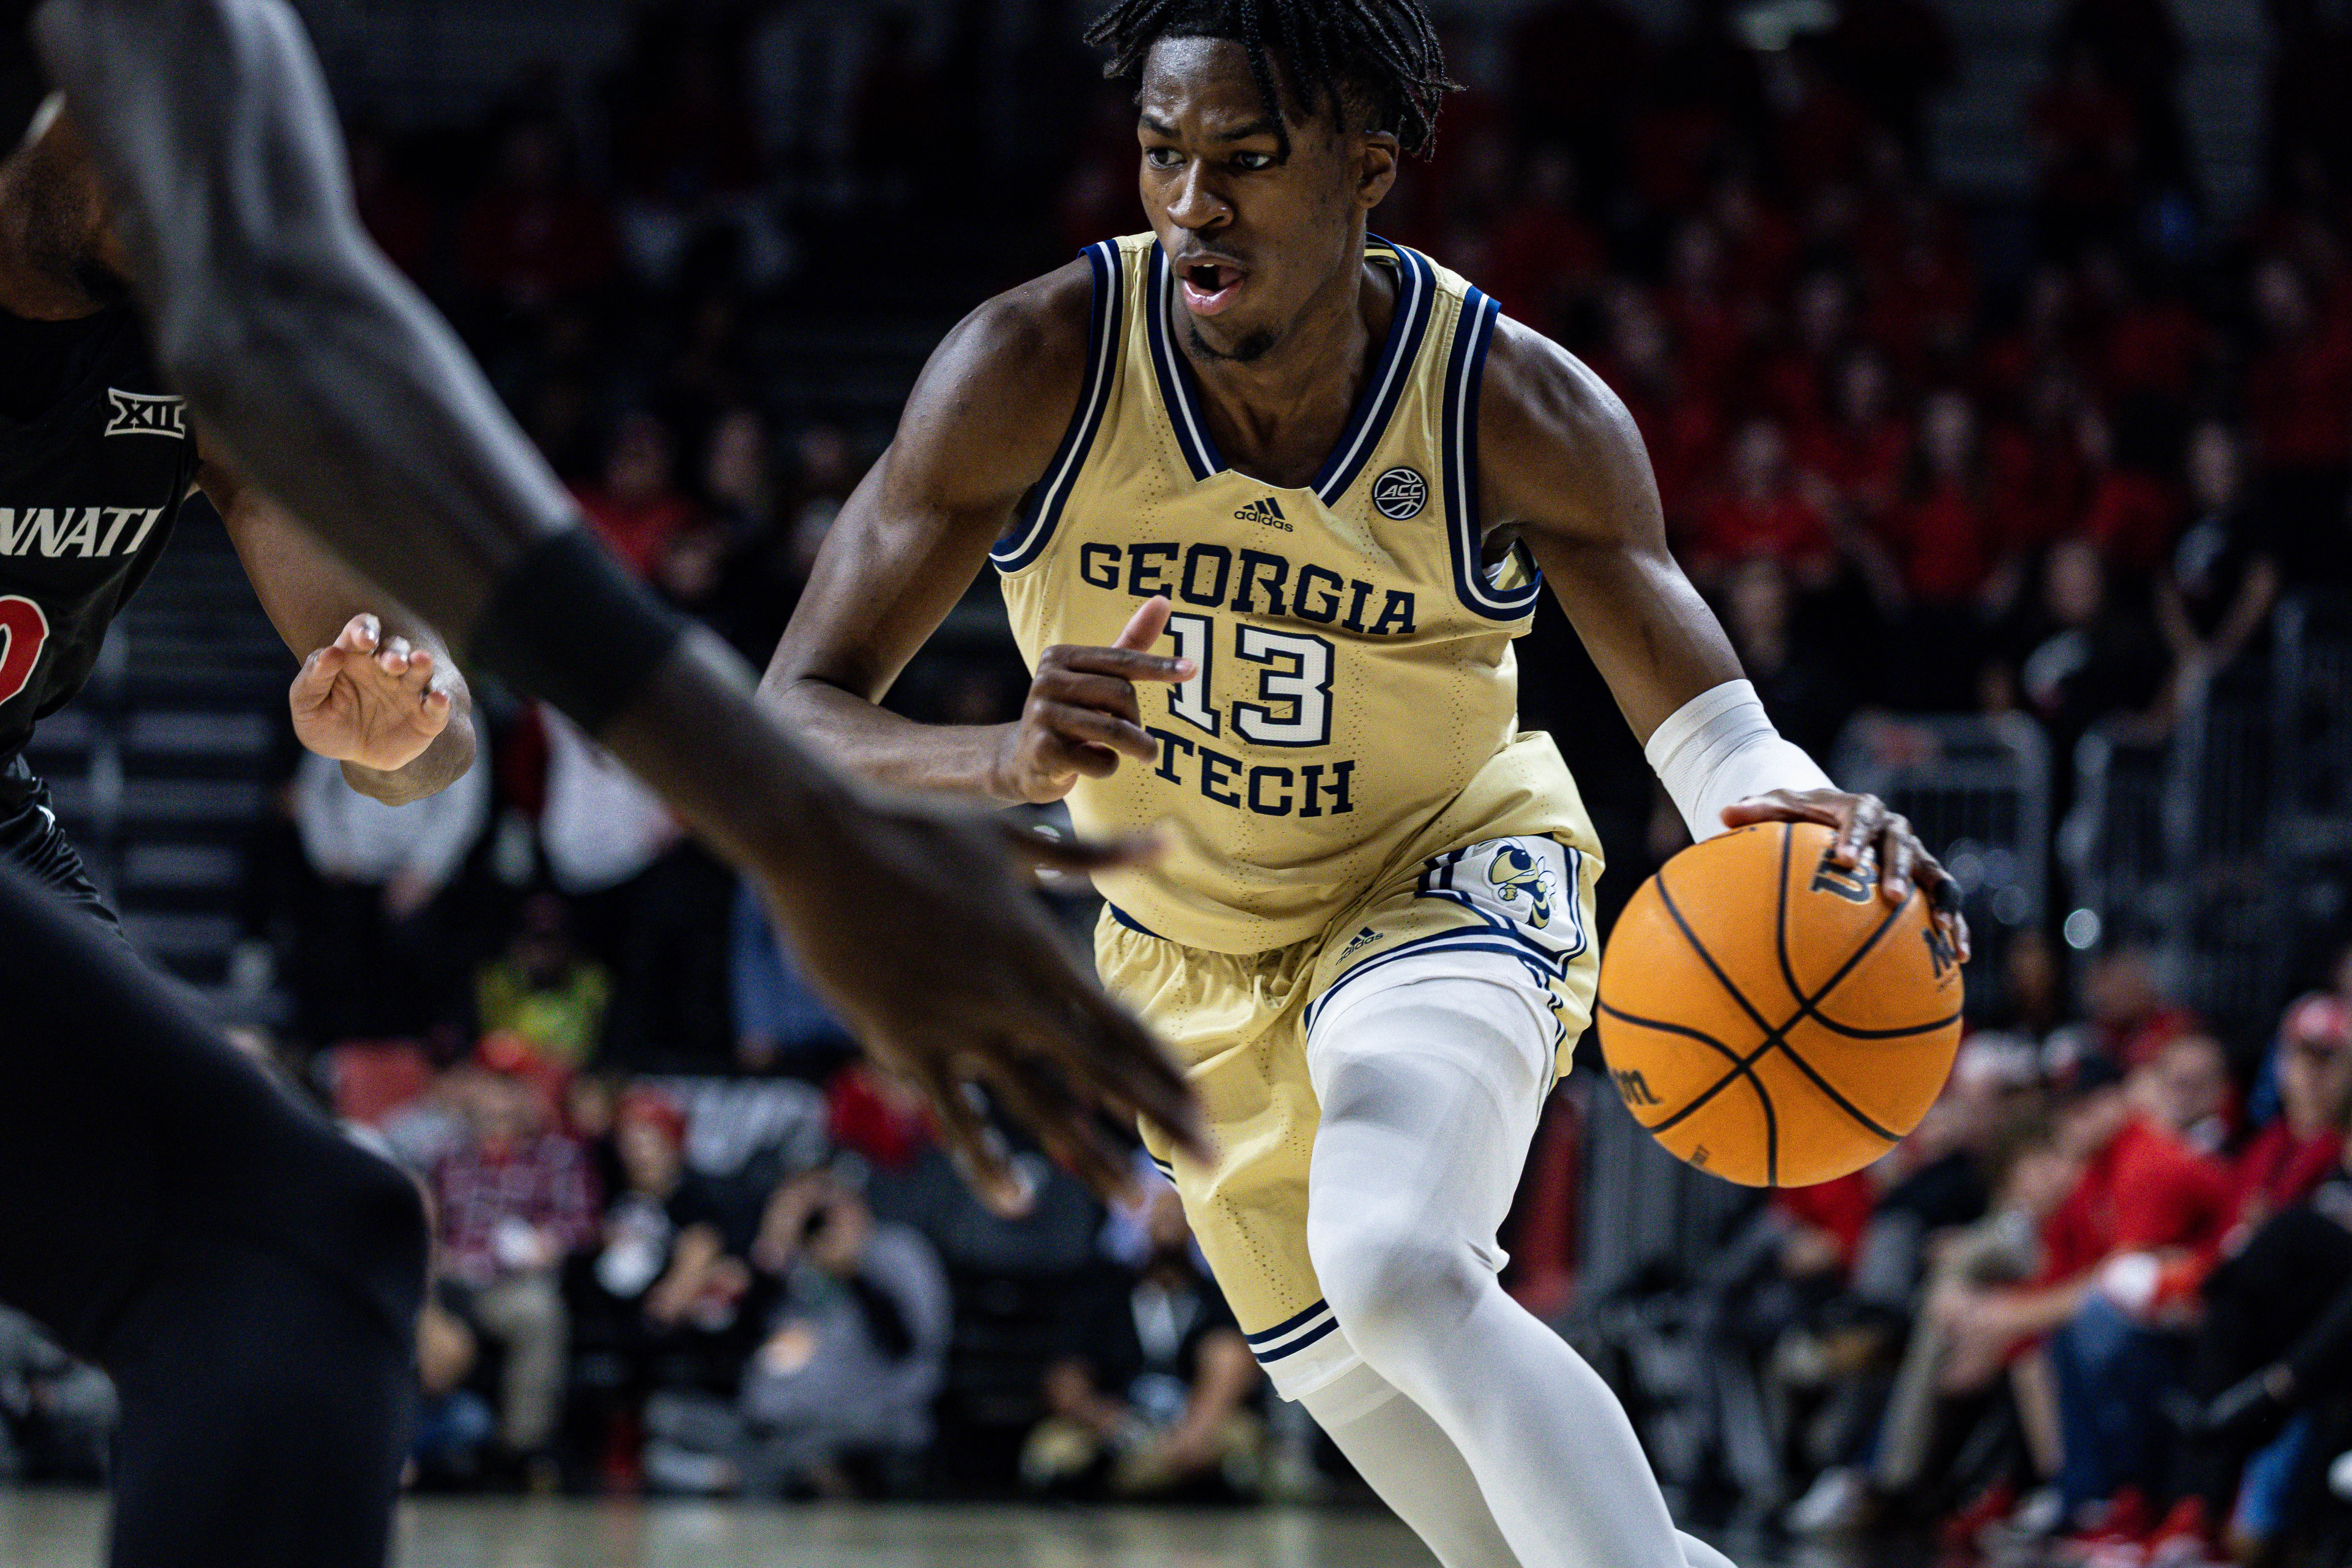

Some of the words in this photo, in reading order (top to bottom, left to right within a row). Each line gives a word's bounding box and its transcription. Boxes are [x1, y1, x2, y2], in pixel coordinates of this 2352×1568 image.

[106, 388, 186, 438] XII
[1380, 483, 1424, 497] ACC
[1234, 511, 1294, 532] adidas
[1080, 542, 1416, 635] GEORGIA
[1163, 611, 1335, 748] 13
[1145, 725, 1355, 818] TECH
[1335, 933, 1384, 966] adidas
